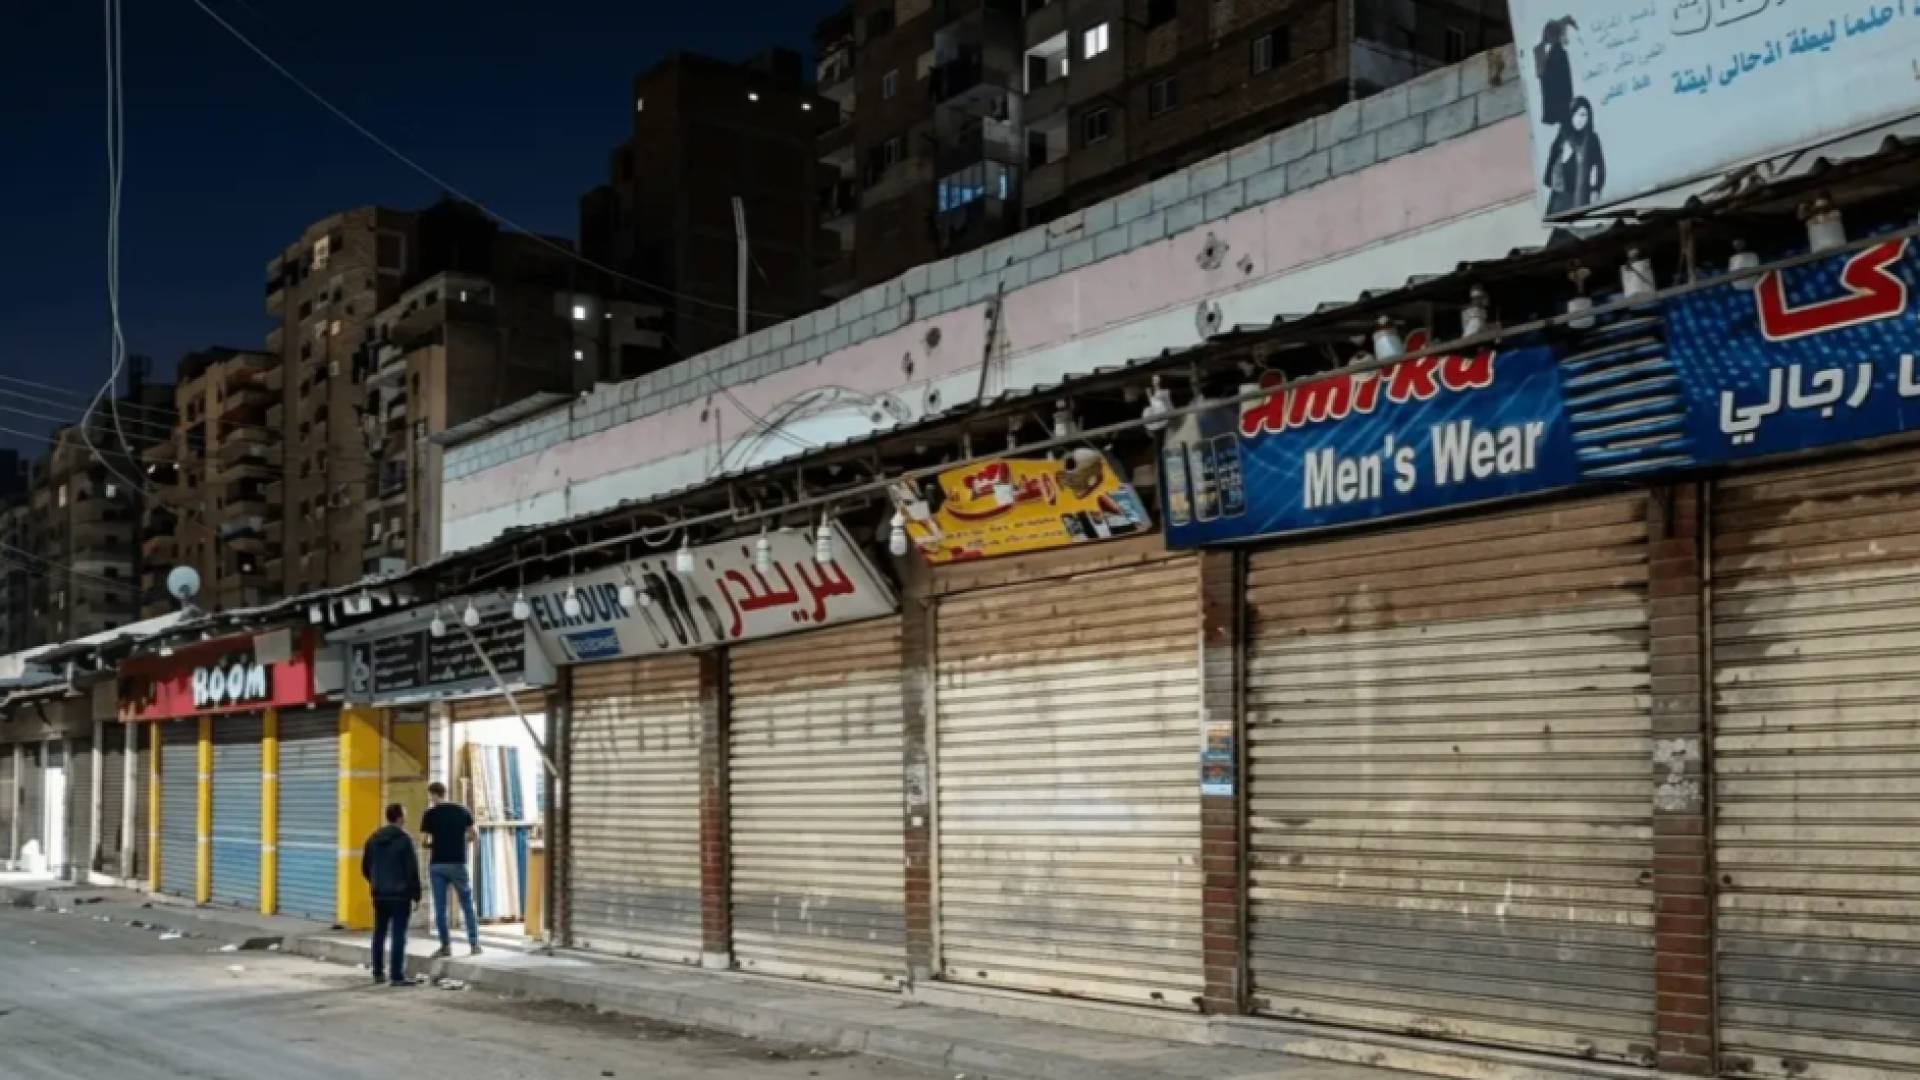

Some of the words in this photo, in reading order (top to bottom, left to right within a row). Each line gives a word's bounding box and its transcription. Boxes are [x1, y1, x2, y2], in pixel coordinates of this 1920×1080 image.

[1720, 363, 1873, 445] رجالي
[1303, 433, 1417, 510] Men's
[1430, 417, 1545, 486] Wear
[192, 662, 266, 708] ROOM
